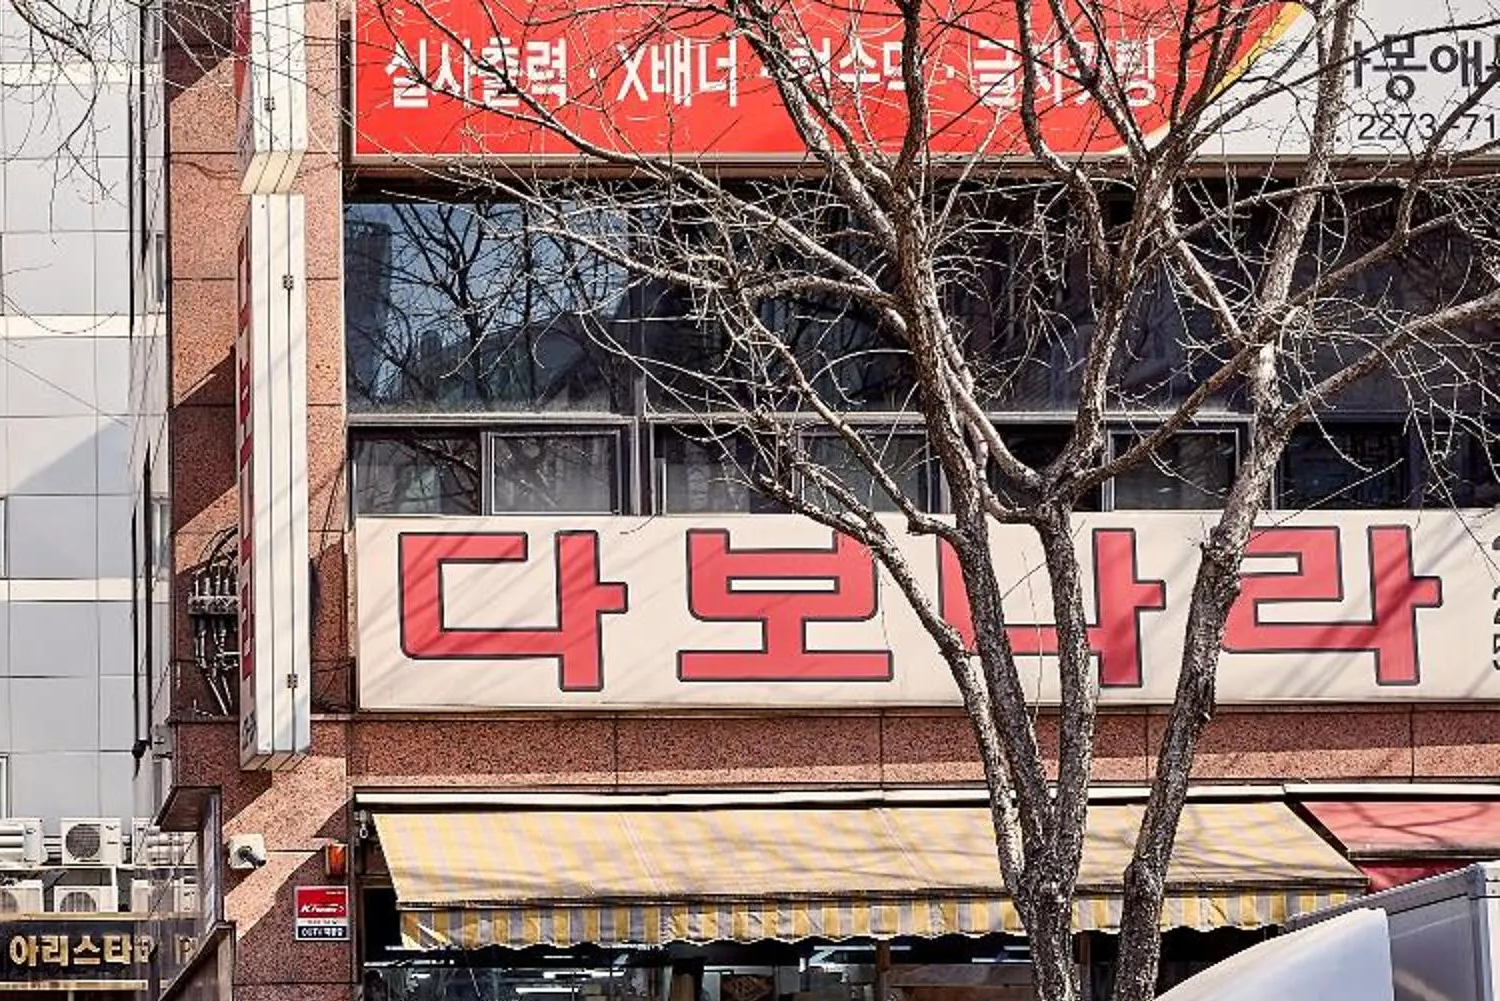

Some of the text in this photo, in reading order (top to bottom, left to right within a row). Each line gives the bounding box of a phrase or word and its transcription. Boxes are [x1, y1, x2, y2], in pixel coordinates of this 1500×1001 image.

[385, 37, 568, 108] 실사출력
[616, 37, 738, 108] X배너
[397, 523, 1442, 692] 다보나라
